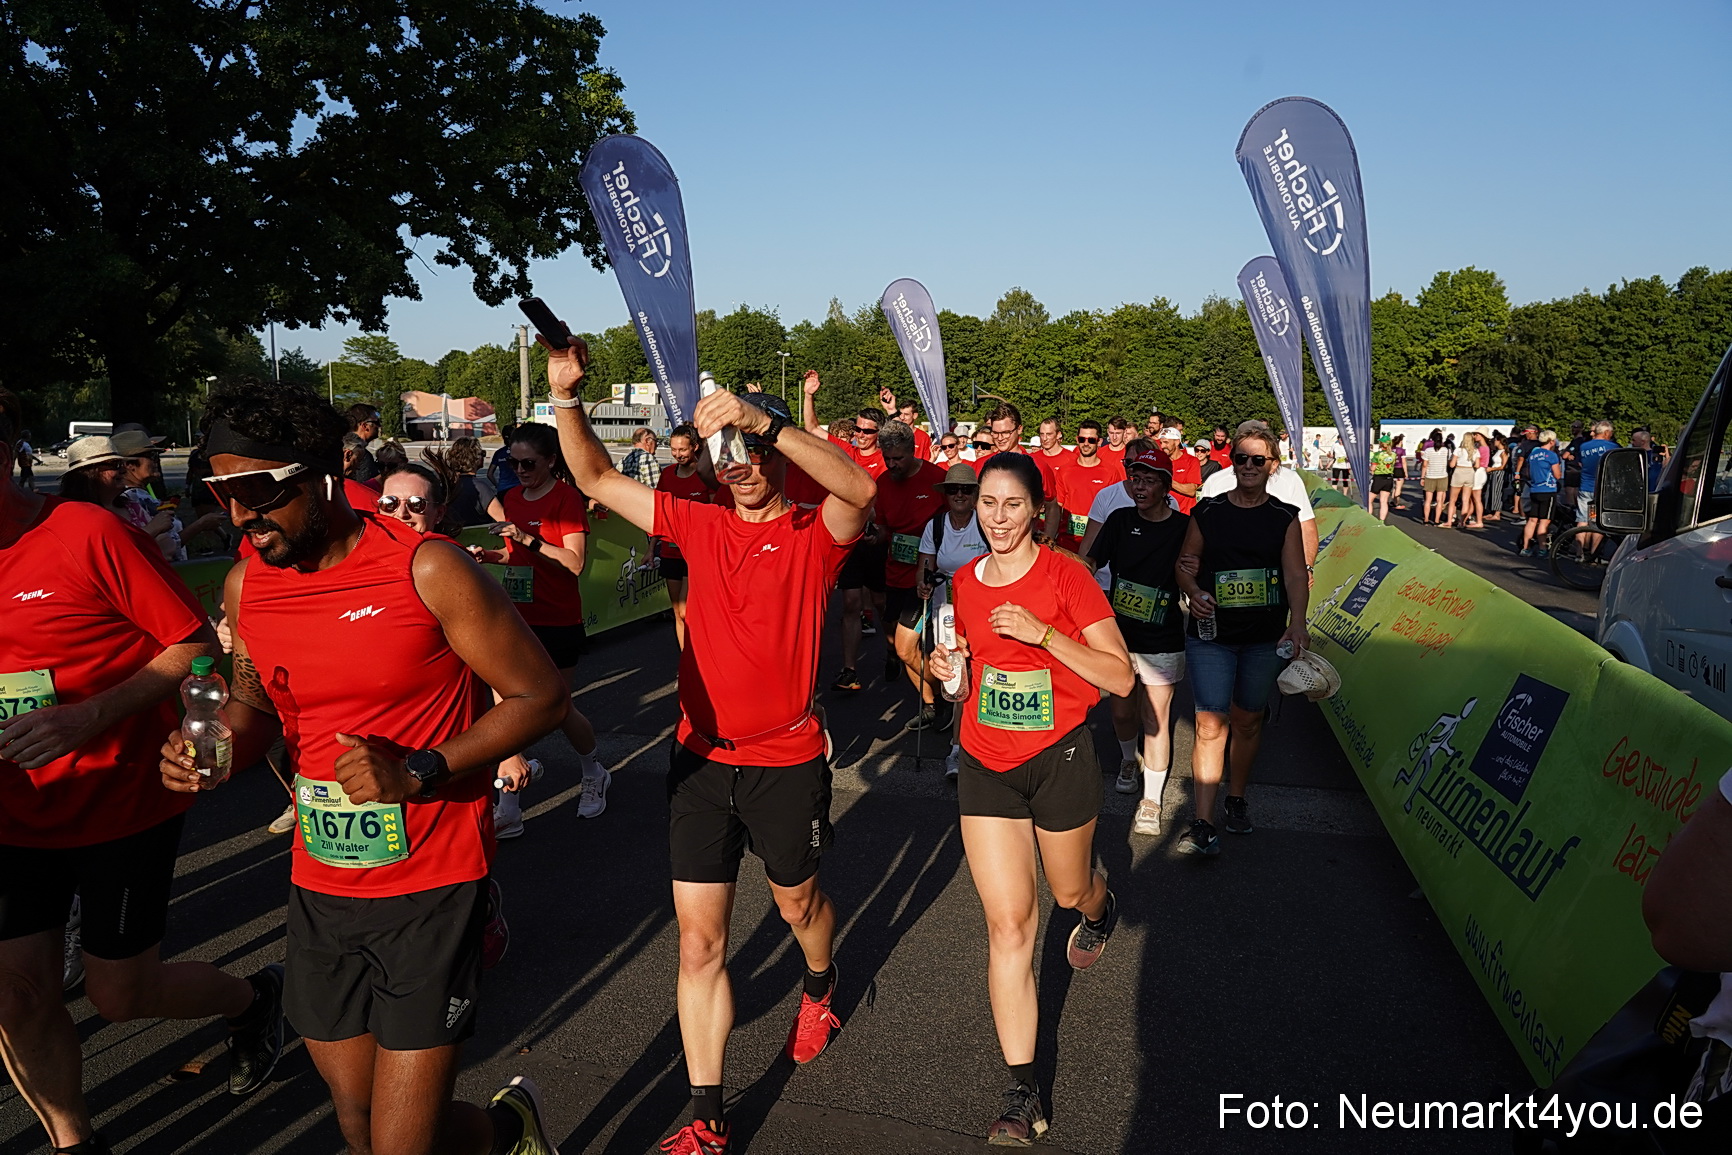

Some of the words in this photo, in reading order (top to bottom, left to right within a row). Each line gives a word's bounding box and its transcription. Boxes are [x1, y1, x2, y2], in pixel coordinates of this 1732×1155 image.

[22, 589, 44, 601] DEHN
[1120, 592, 1143, 608] 272
[1227, 582, 1254, 596] 303
[350, 605, 373, 622] DEHN
[1315, 602, 1381, 655] firmenlauf
[986, 708, 1011, 720] Nicklas
[1012, 712, 1042, 721] Simone
[988, 688, 1041, 712] 1684
[1042, 693, 1050, 722] 2022
[1503, 708, 1544, 742] Fischer
[1500, 730, 1533, 753] AUTOMOBILE
[1602, 735, 1703, 824] Gesunde
[301, 814, 313, 844] RUN
[308, 809, 382, 840] 1676
[383, 812, 400, 852] 2022
[810, 828, 821, 848] cep
[1415, 804, 1465, 859] neumarkt
[1427, 750, 1582, 898] firmenlauf
[320, 839, 334, 850] Zill
[335, 842, 370, 853] Walter
[1612, 823, 1662, 886] lau
[445, 998, 471, 1029] adidas
[1661, 1003, 1694, 1046] Niko
